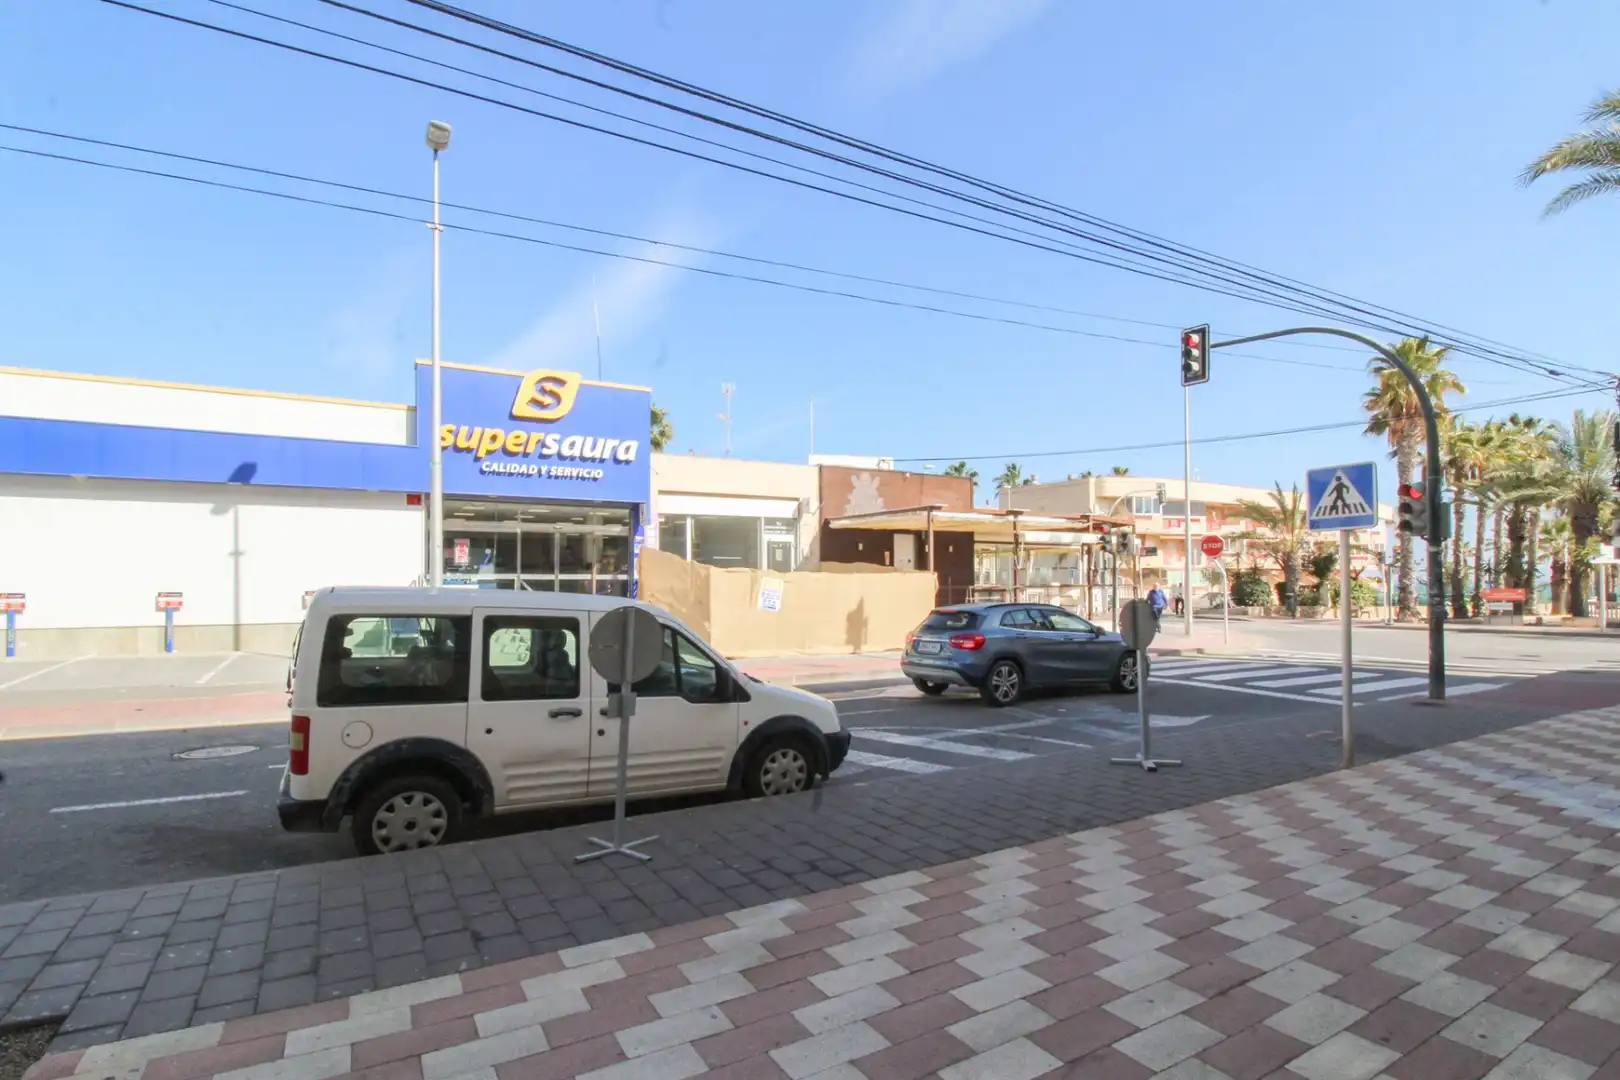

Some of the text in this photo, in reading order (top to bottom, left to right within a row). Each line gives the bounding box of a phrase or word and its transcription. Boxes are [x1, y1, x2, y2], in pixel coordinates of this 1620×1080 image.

[440, 423, 640, 461] supersaura
[481, 461, 604, 479] CALIDAD Y SERVICIO
[1203, 542, 1222, 550] STOP
